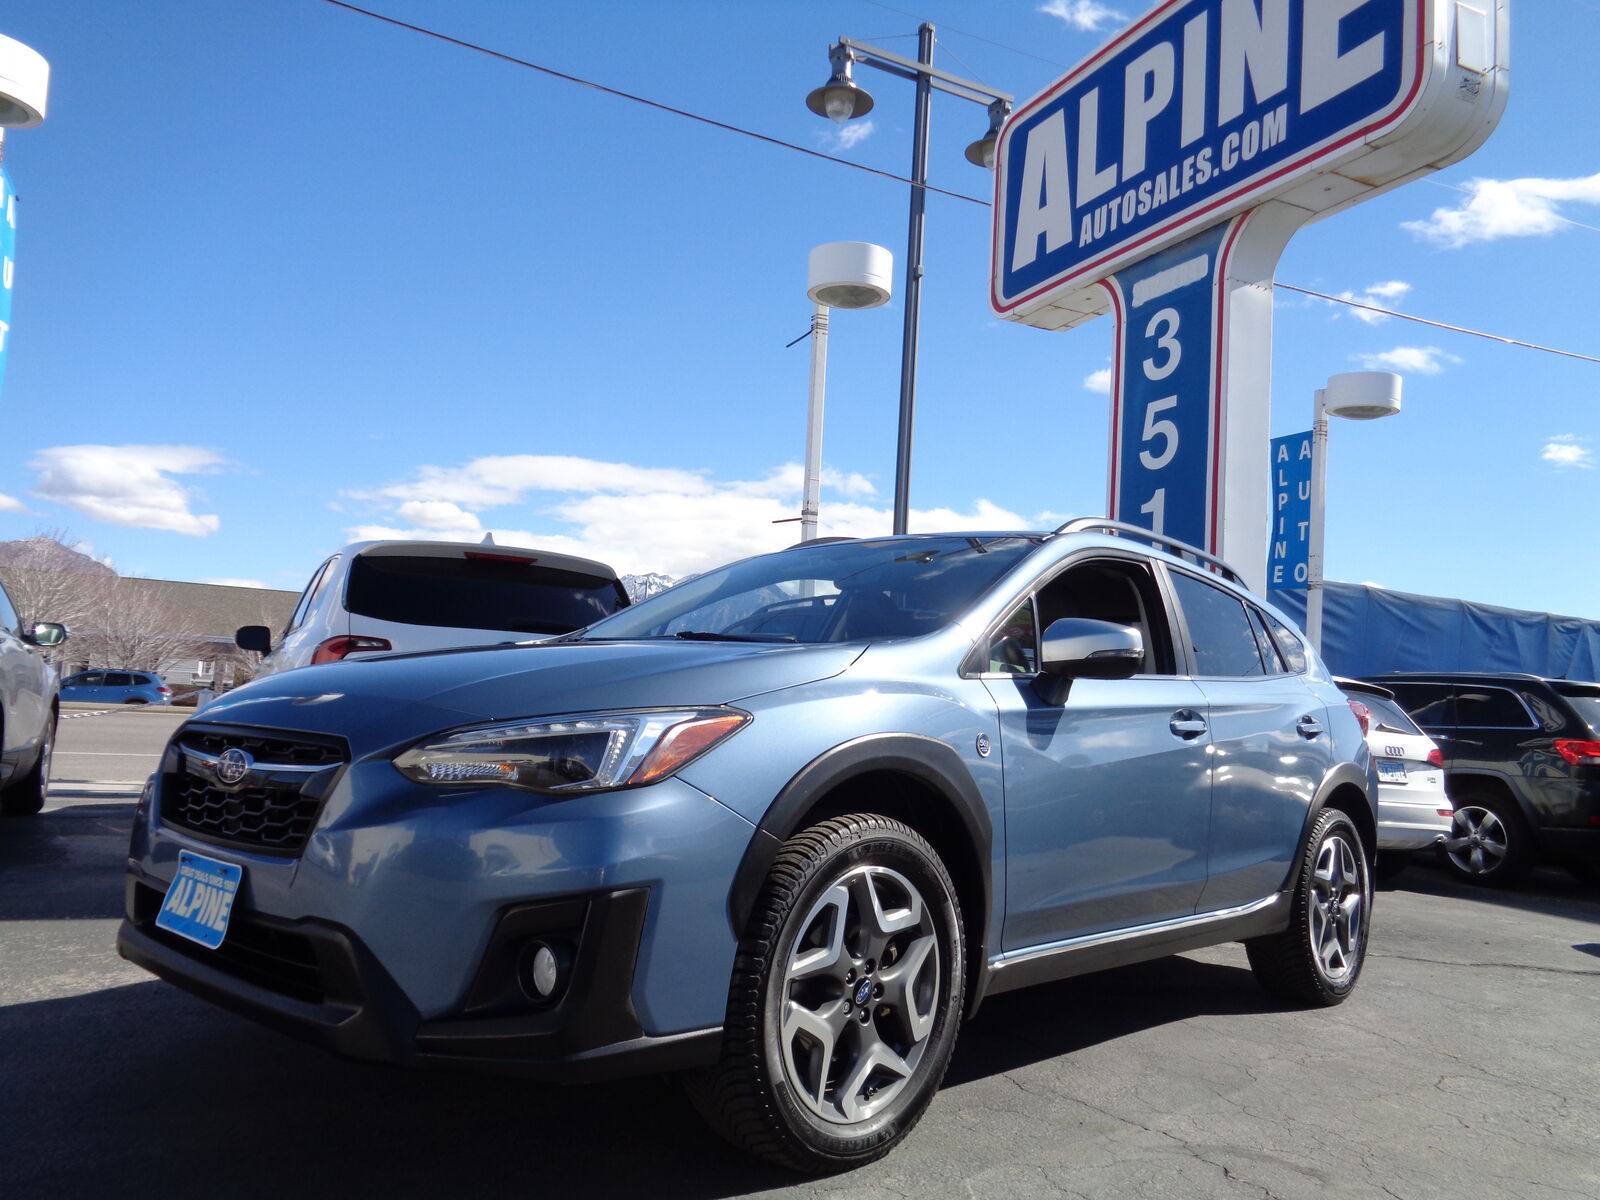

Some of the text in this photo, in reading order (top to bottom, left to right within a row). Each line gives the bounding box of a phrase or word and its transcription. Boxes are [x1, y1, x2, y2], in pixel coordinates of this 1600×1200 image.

[1011, 0, 1385, 273] ALPINE
[1079, 103, 1288, 249] AUTOSALES.COM
[1273, 444, 1288, 583] ALPINE
[1294, 440, 1311, 583] AUTO
[165, 877, 233, 931] ALPINE
